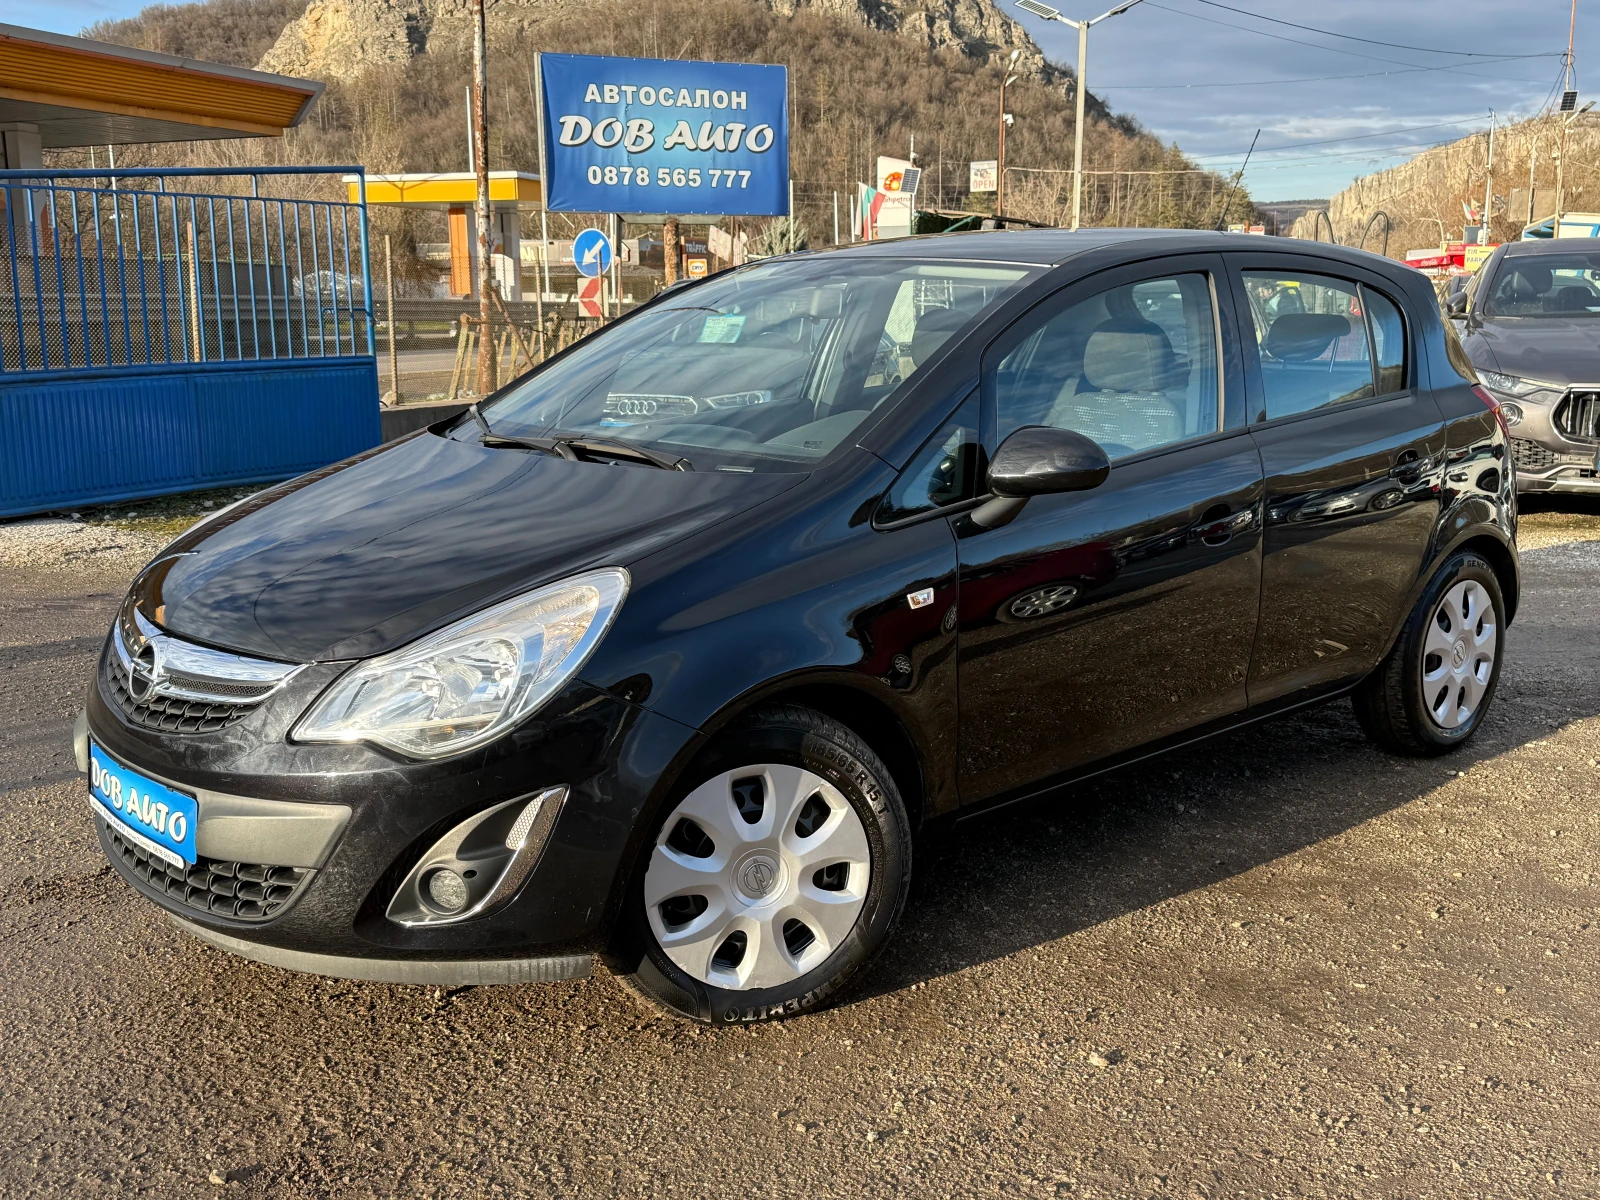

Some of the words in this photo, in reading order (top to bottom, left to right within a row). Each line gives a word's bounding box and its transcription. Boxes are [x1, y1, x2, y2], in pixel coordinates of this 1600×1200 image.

[584, 83, 747, 110] АВТОСАЛОН
[559, 115, 655, 154] DOB
[663, 120, 774, 154] AUTO
[587, 165, 650, 187] 0878
[656, 168, 702, 188] 565
[708, 169, 752, 189] 777
[972, 179, 995, 189] OPEN
[91, 756, 123, 811] DOB
[126, 787, 187, 844] AUTO
[855, 769, 869, 786] R
[866, 783, 882, 802] 15
